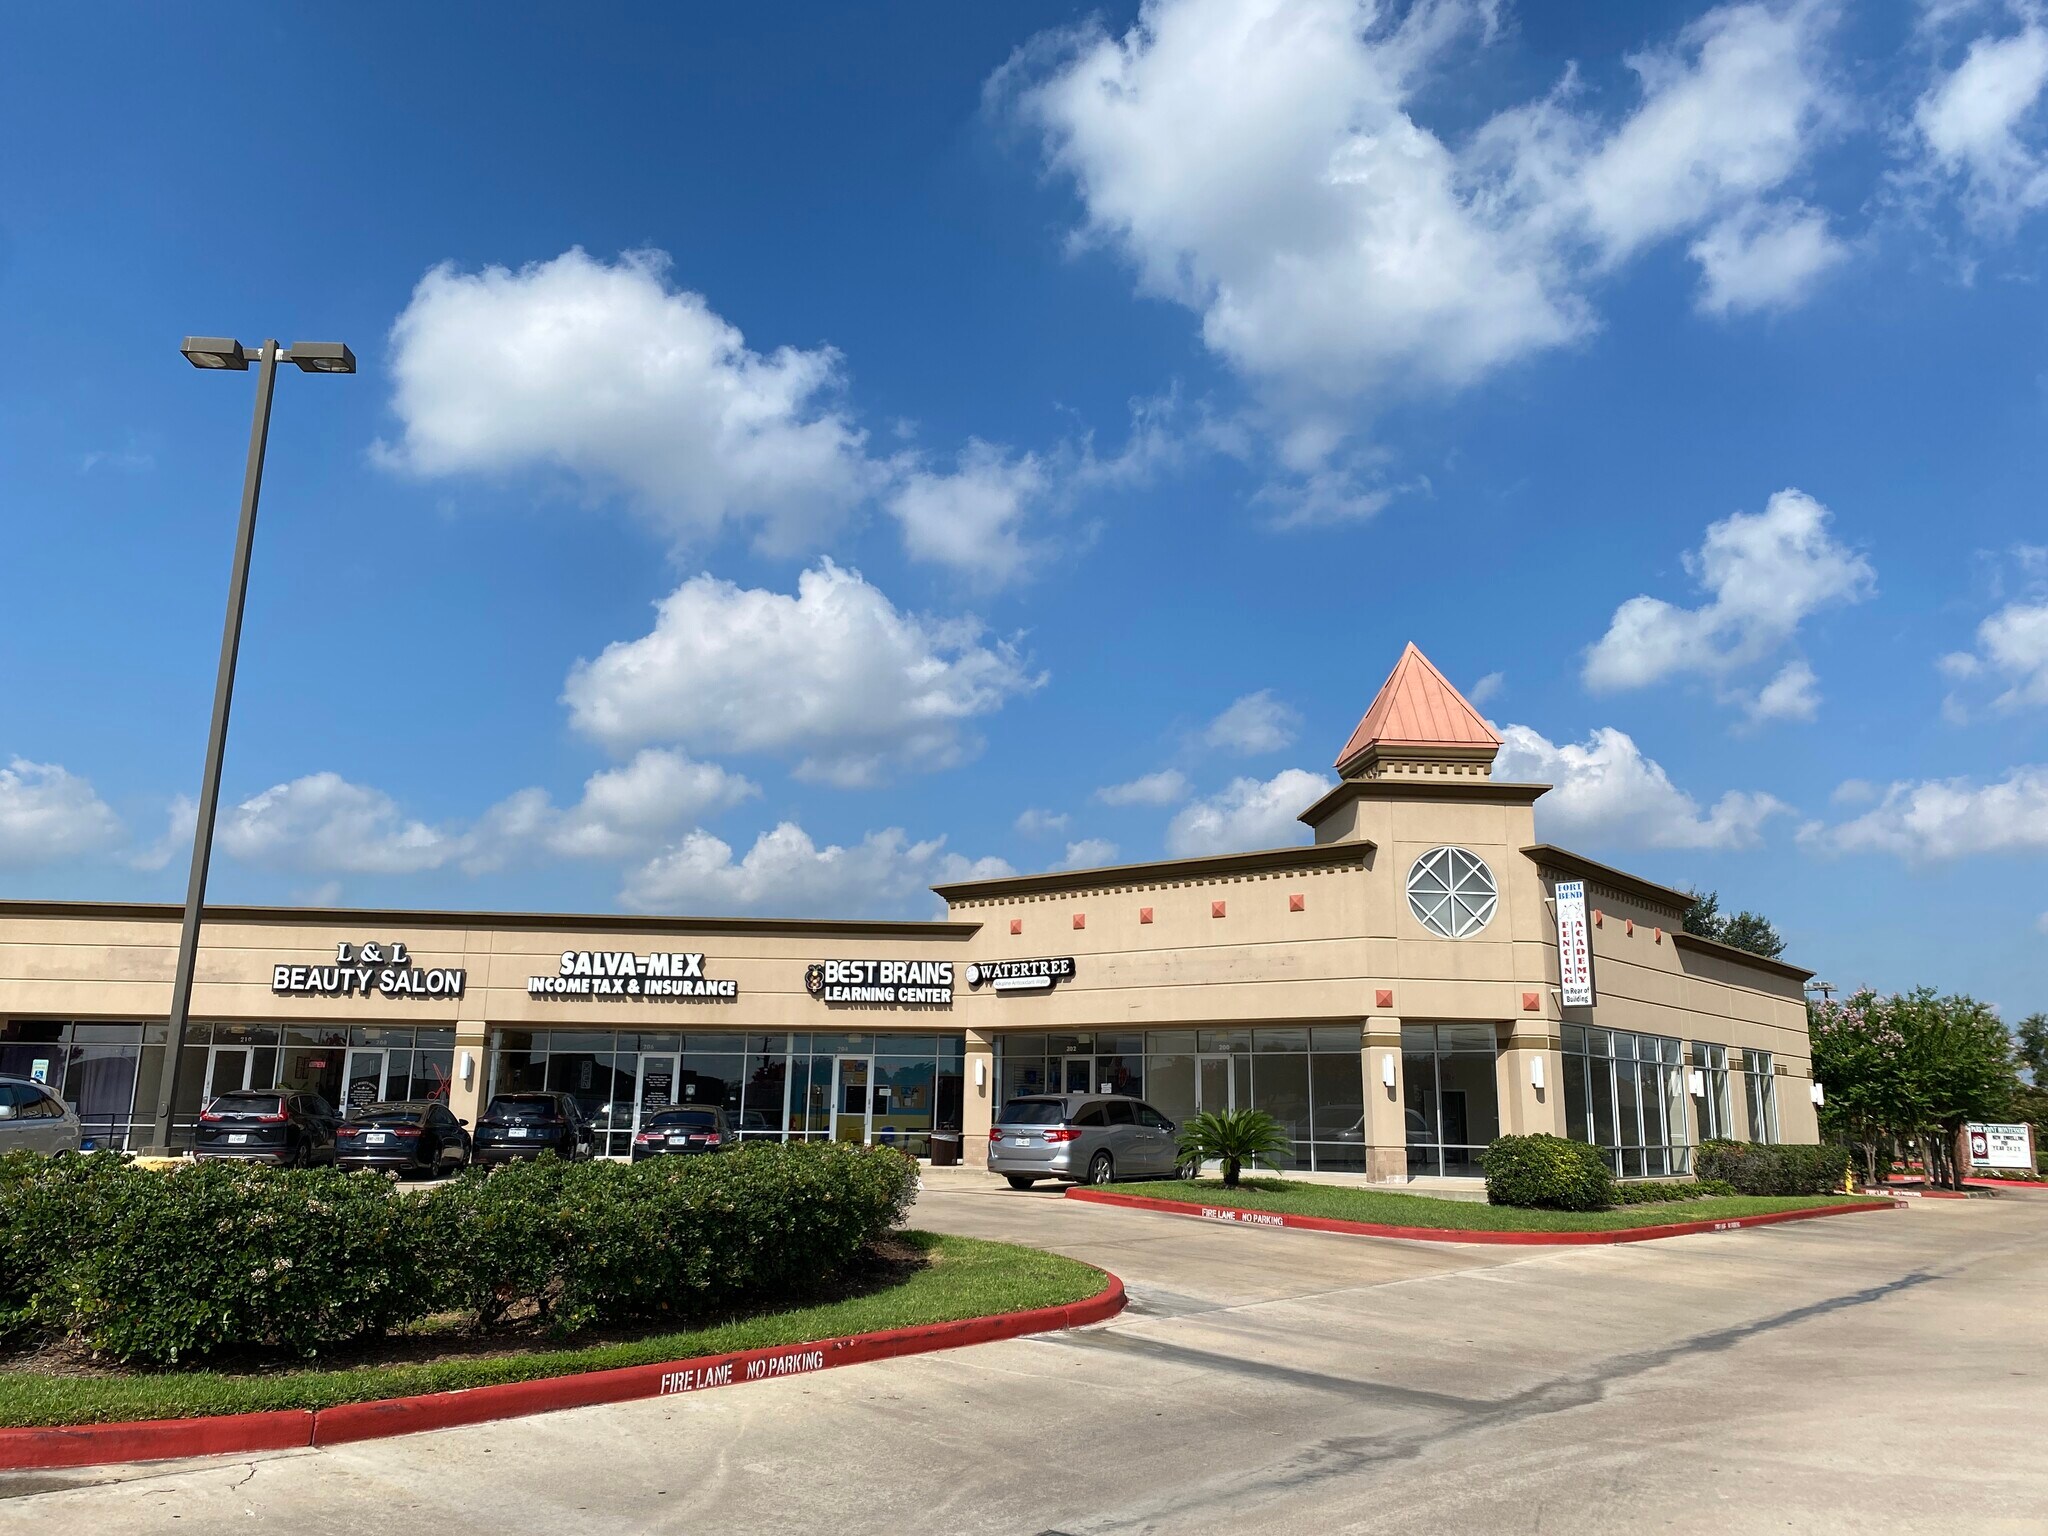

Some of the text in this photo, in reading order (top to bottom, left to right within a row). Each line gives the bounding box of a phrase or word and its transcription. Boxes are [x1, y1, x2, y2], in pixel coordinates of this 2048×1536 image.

[1558, 883, 1582, 892] FORT
[1558, 891, 1583, 900] BEND
[337, 943, 407, 963] L & L
[1561, 921, 1574, 984] FENCING
[1575, 921, 1587, 984] ACADEMY
[559, 951, 703, 977] SALVA-MEX
[825, 960, 953, 985] BEST BRAINS
[980, 960, 1070, 978] WATERTREE
[273, 967, 461, 993] BEAUTY SALON
[528, 977, 736, 996] INCOME TAX & INSURANCE
[825, 986, 952, 1003] LEARNING CENTER
[1566, 995, 1589, 1003] Building
[1570, 987, 1583, 995] Rear
[1201, 1207, 1283, 1226] FIRE LANE NO PARKING
[660, 1351, 823, 1395] FIRE LANE NO PARKING
